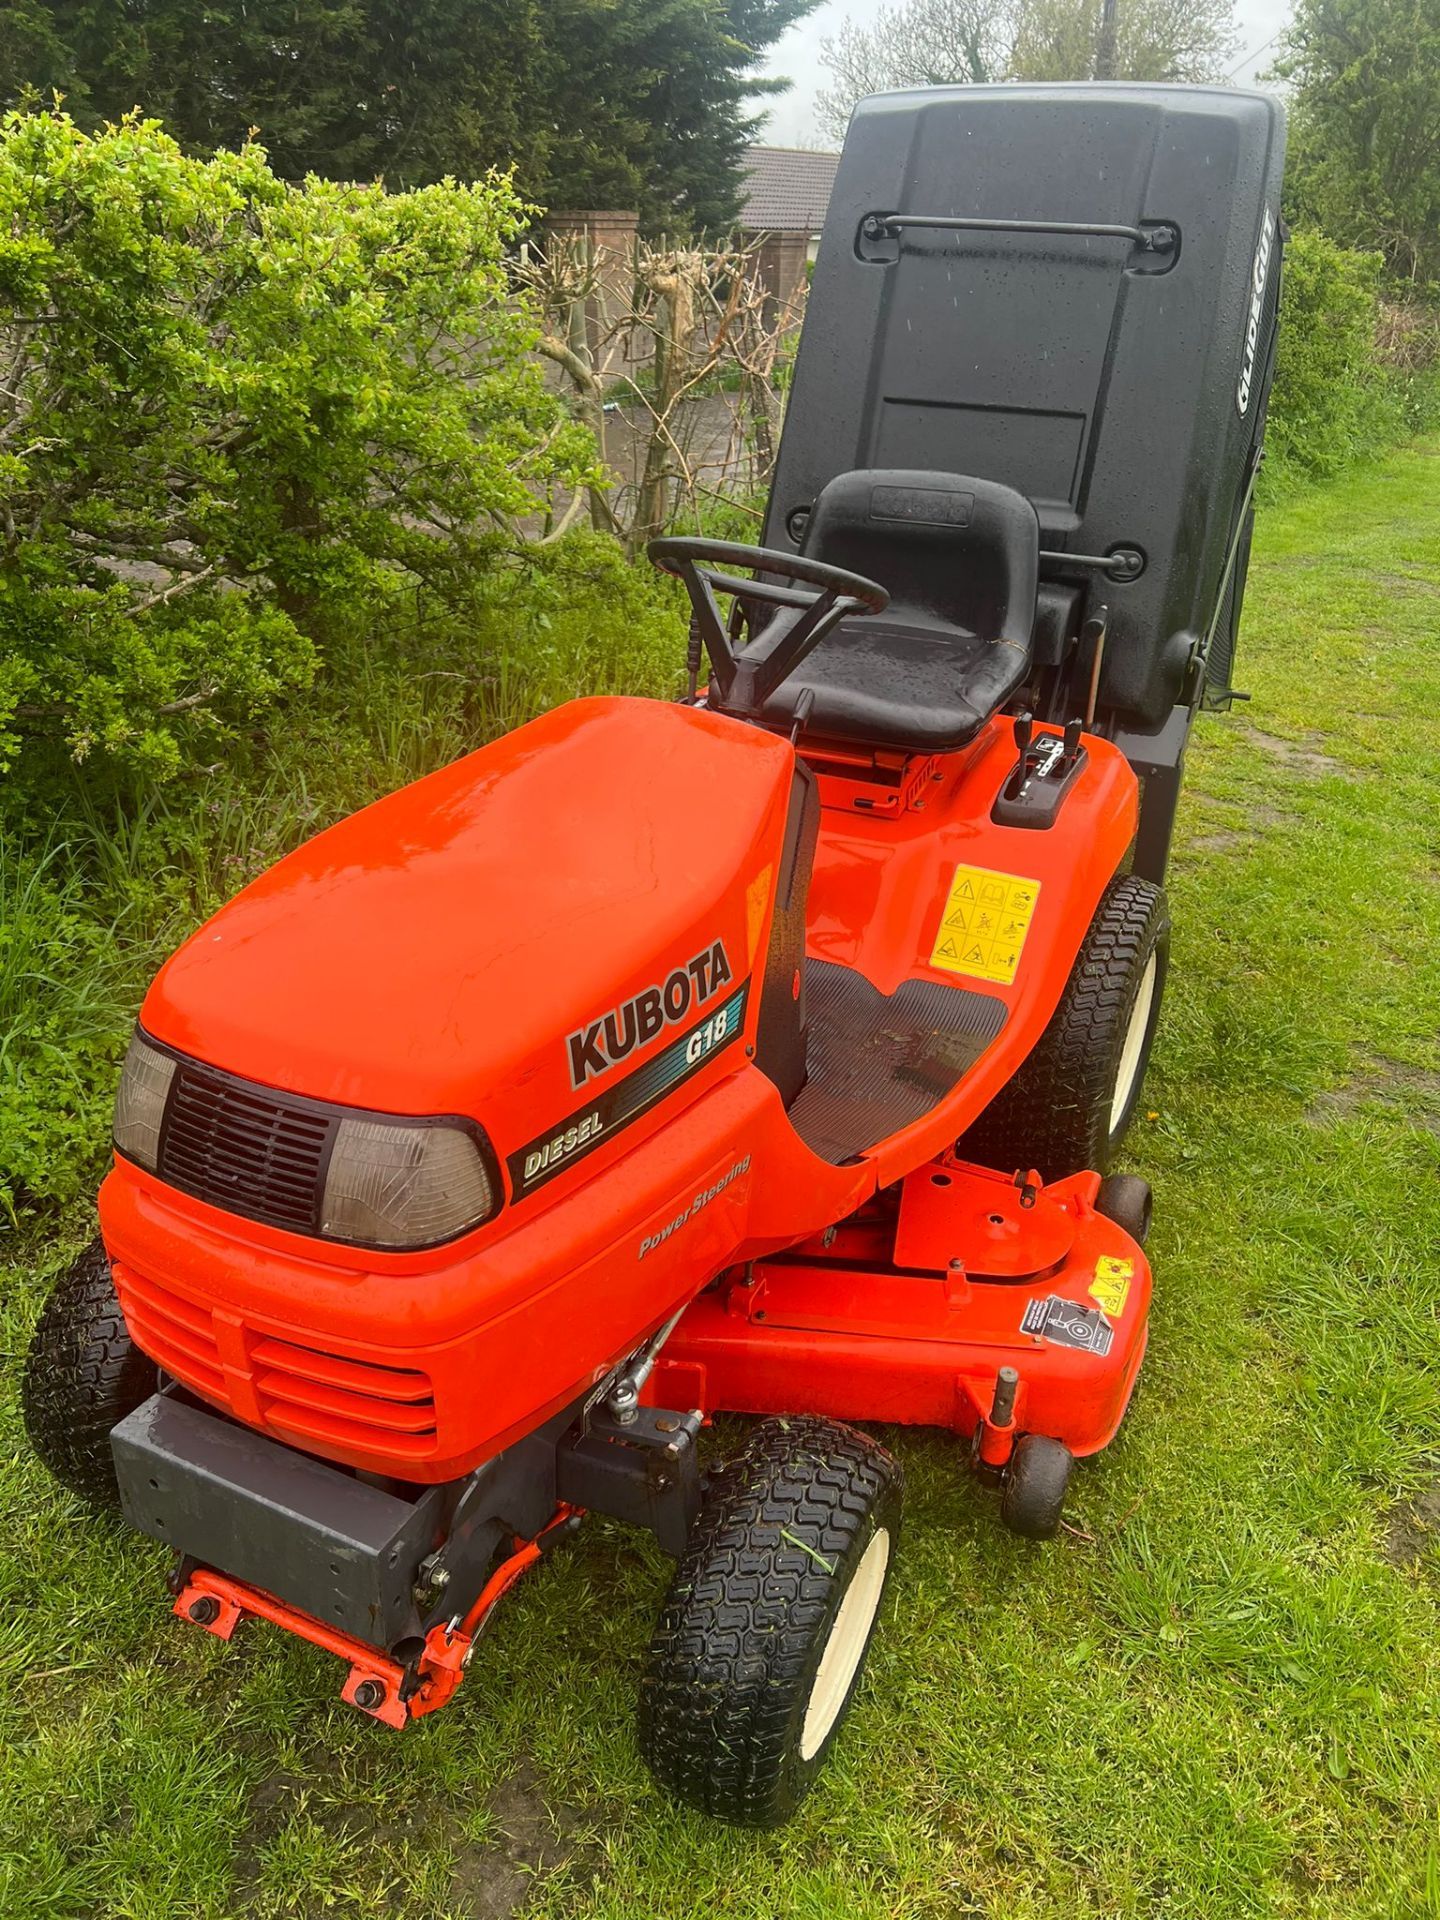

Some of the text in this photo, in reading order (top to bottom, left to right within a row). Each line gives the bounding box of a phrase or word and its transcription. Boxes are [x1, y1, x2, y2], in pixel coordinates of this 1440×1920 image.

[566, 937, 732, 1091] KUBOTA
[686, 1010, 728, 1064] G18
[524, 1111, 603, 1179] DIESEL
[638, 1154, 751, 1260] Power Steering
